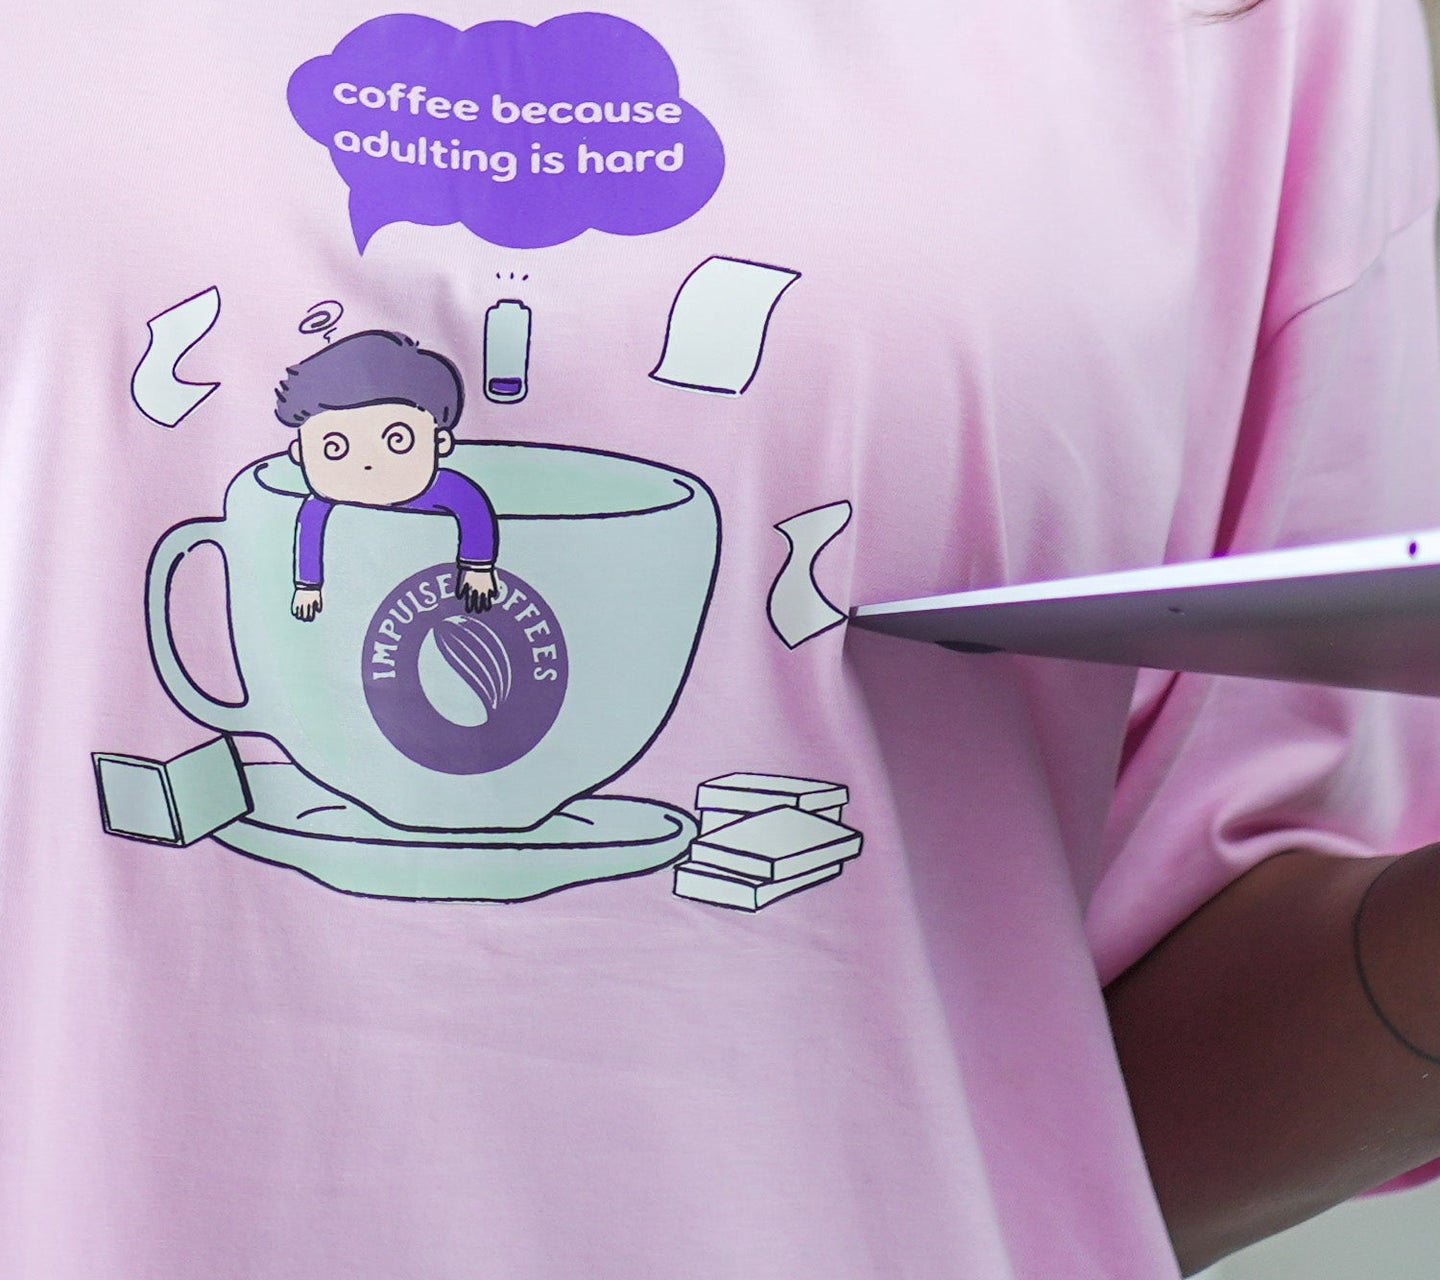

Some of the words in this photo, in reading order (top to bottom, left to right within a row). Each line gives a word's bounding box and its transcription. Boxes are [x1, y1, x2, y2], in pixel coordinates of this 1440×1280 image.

[332, 81, 480, 122] coffee
[491, 93, 683, 125] because
[333, 129, 518, 183] adulting
[530, 142, 566, 174] is
[577, 142, 685, 174] hard
[371, 573, 456, 681] IMPULSE
[484, 577, 558, 682] OFFEES
